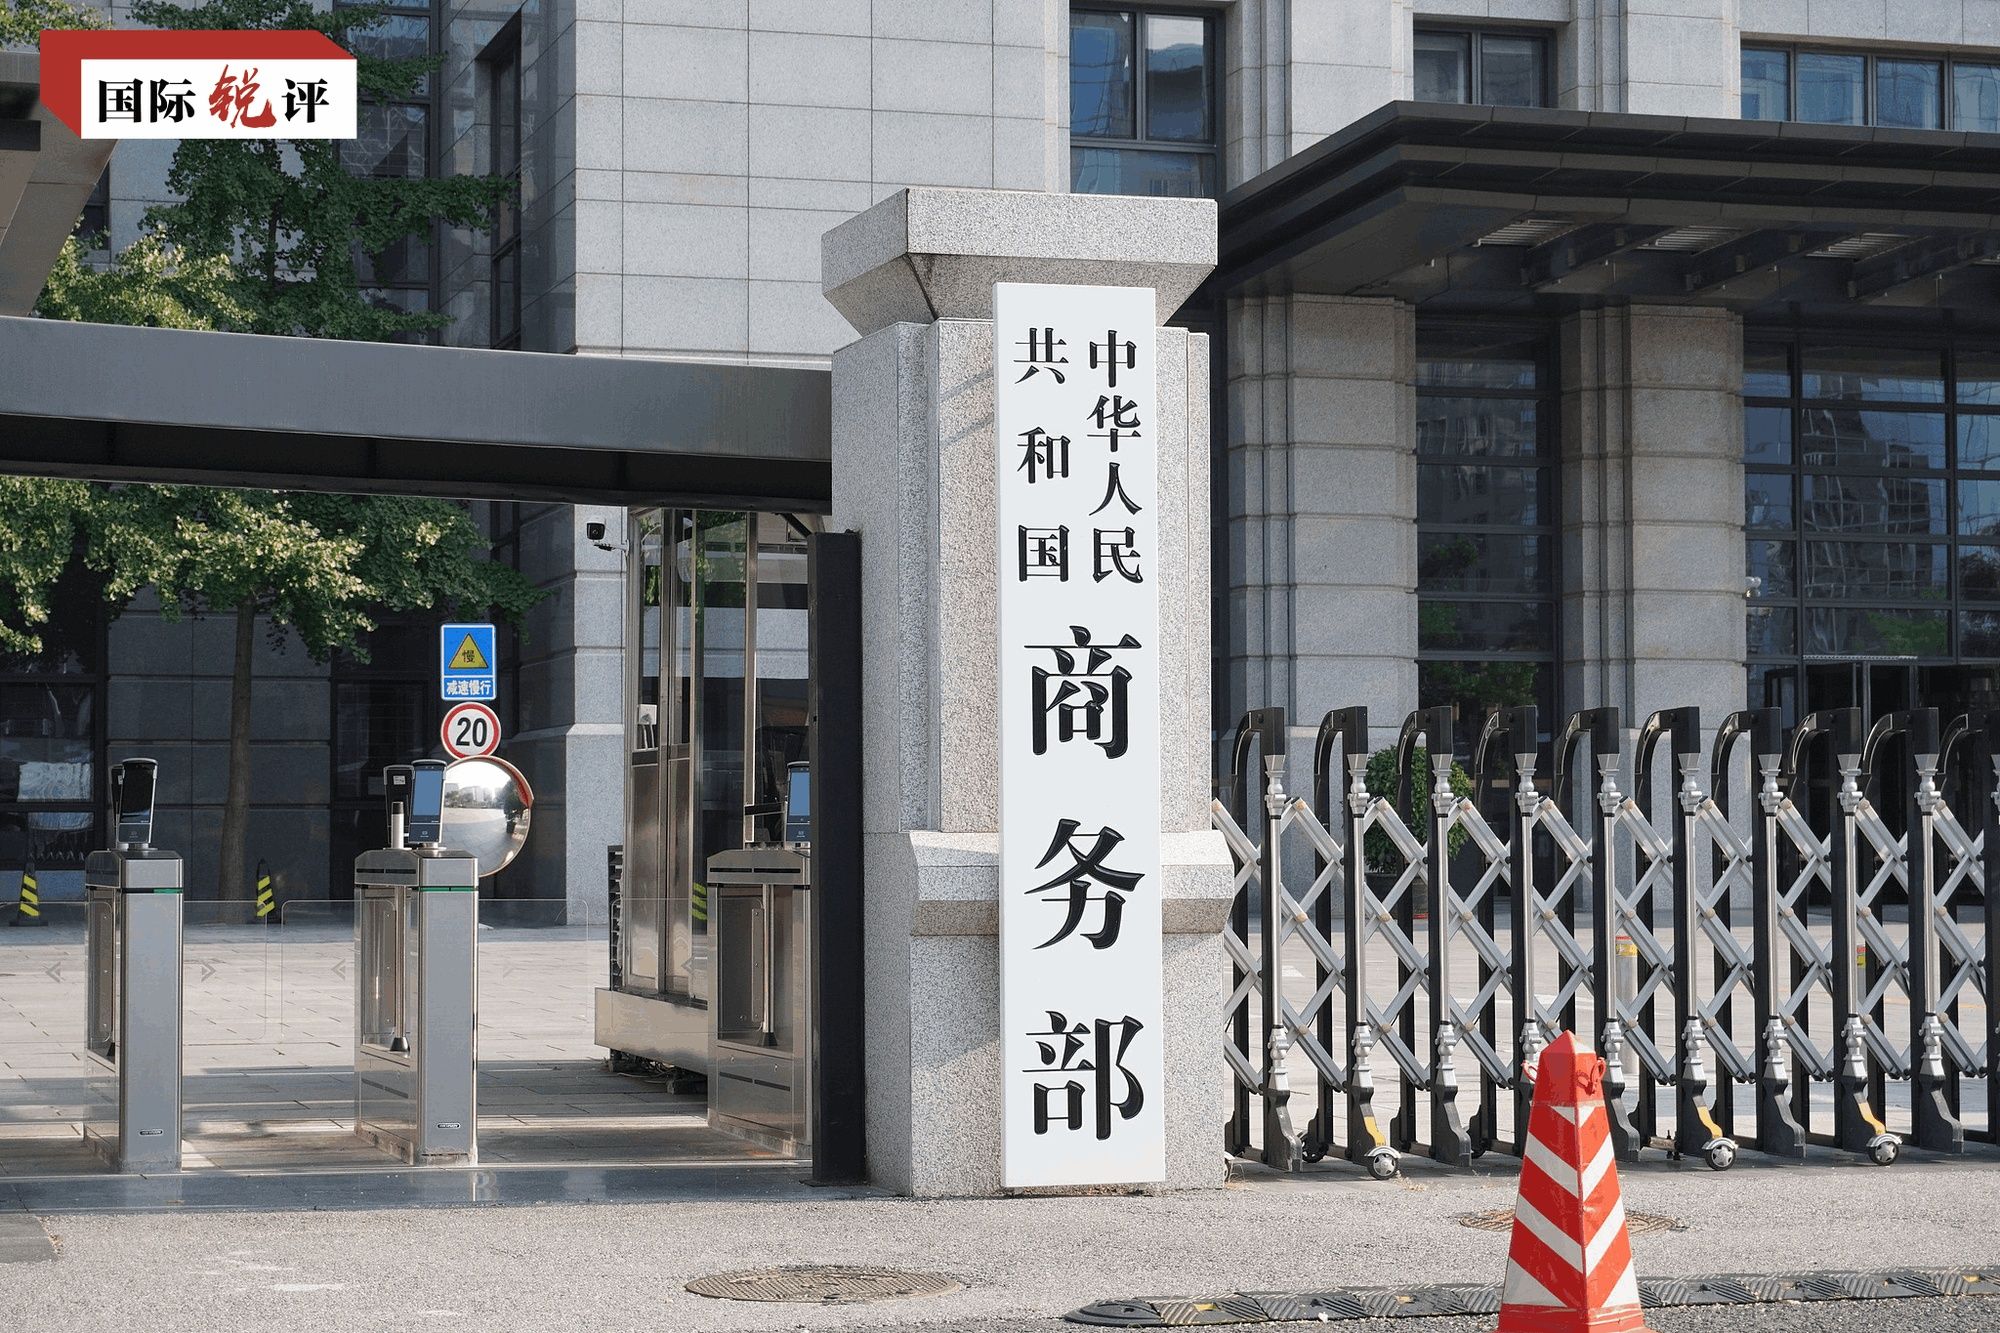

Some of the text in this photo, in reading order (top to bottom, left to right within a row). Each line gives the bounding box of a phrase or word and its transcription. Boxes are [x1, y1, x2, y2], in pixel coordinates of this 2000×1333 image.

[1013, 327, 1071, 583] 共和国
[1086, 329, 1144, 584] 中华人民
[446, 680, 492, 695] 减速慢行
[462, 649, 475, 663] 慢
[455, 717, 488, 747] 20
[1022, 625, 1146, 1141] 商务部
